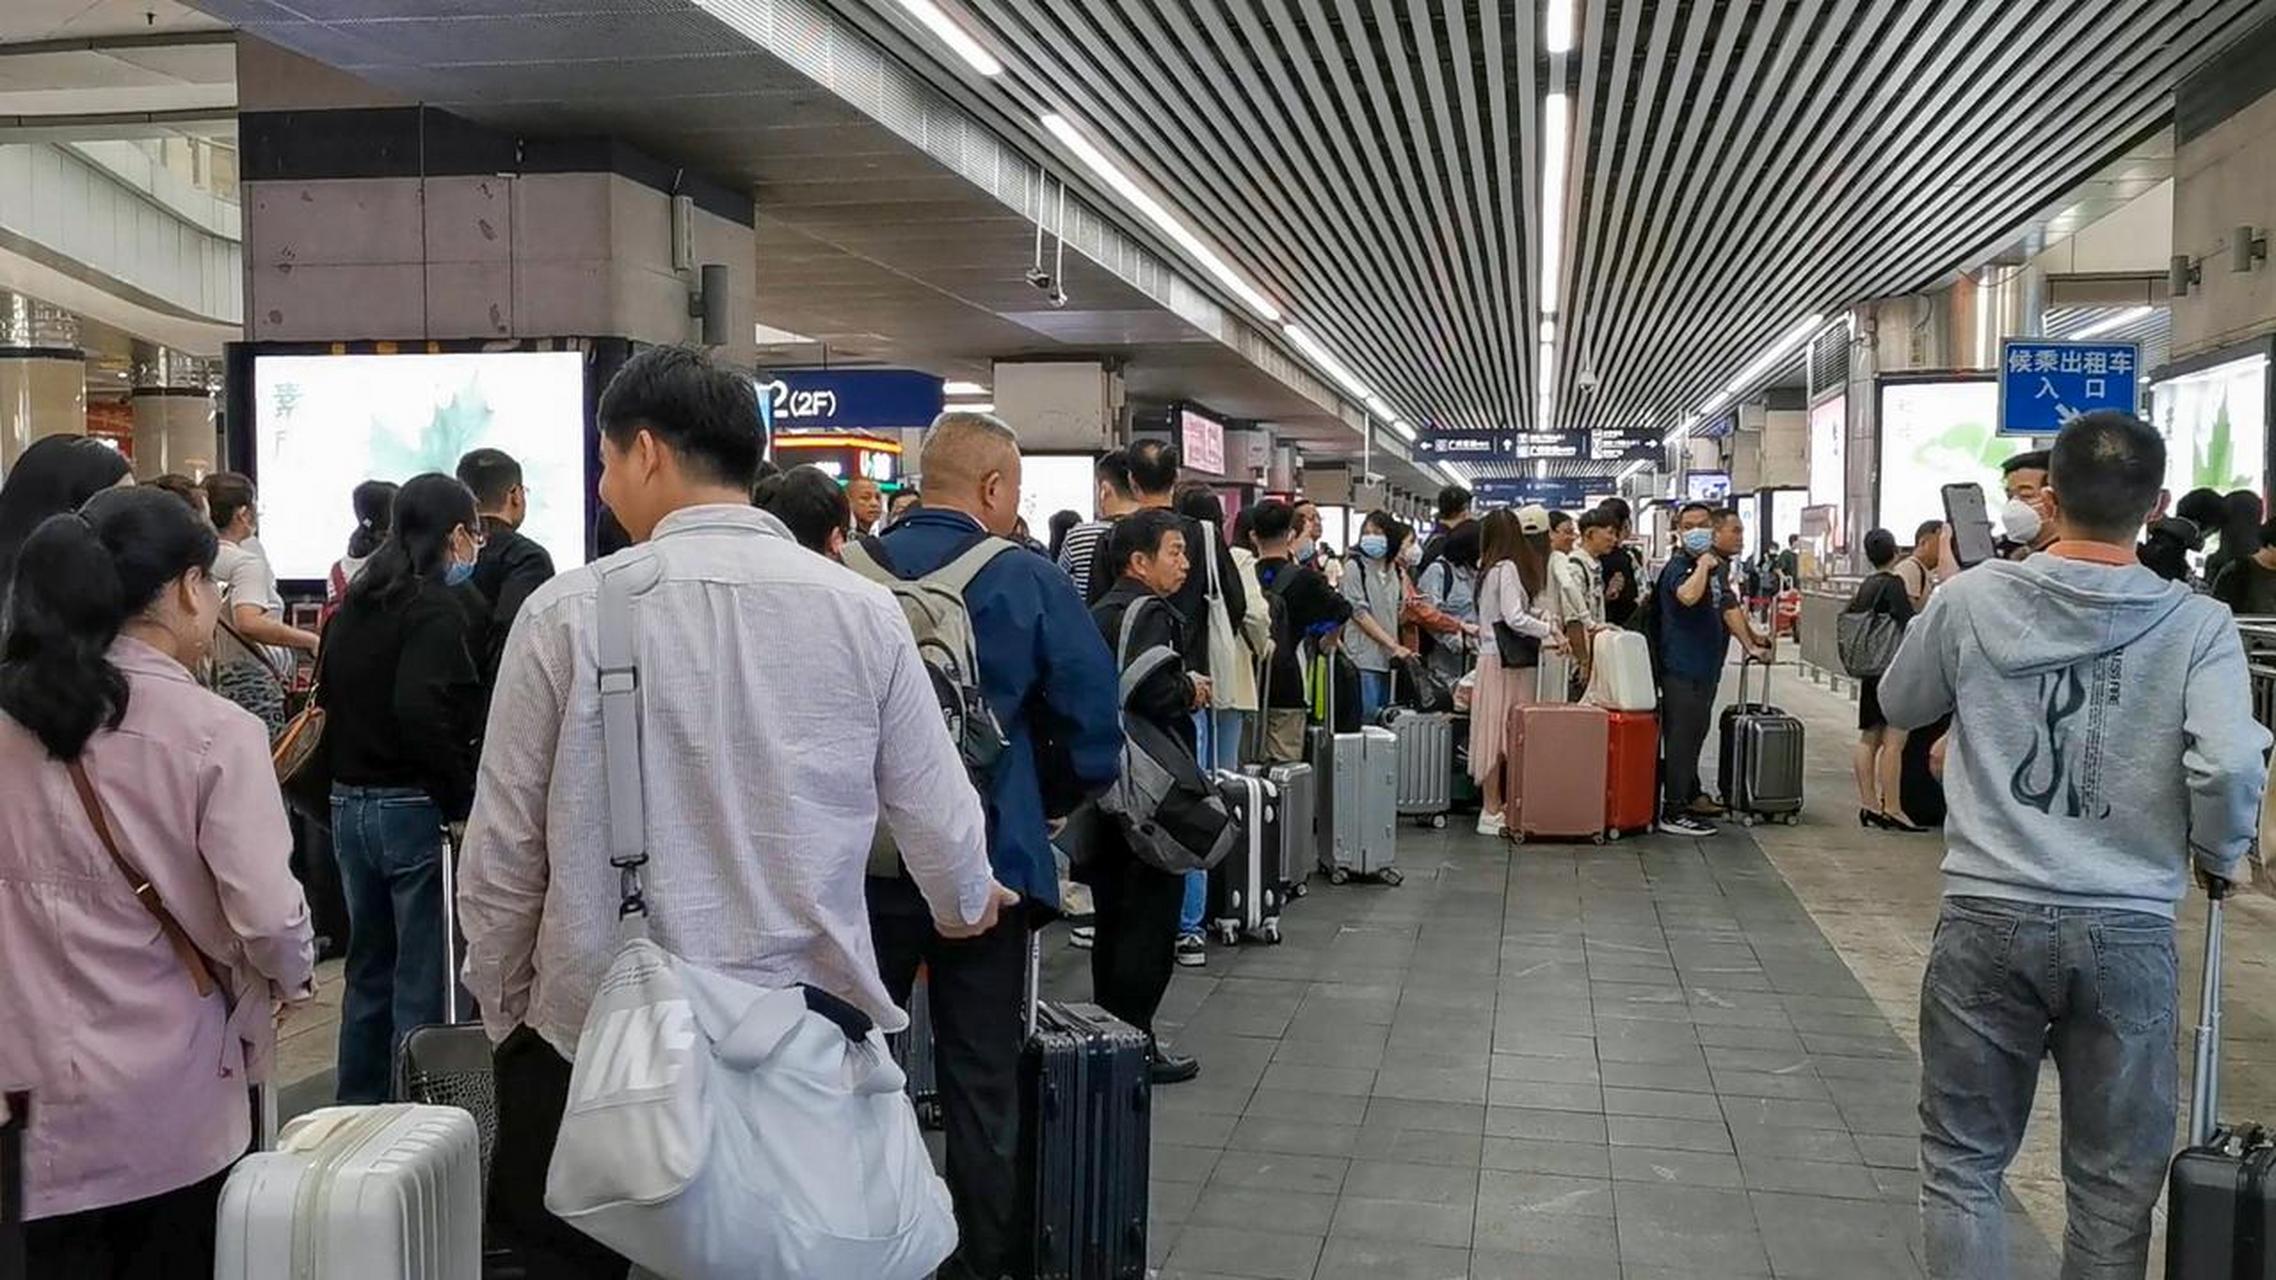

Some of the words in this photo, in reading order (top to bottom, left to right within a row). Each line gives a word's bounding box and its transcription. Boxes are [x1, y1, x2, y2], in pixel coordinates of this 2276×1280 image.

[2008, 350, 2134, 375] 候乘出租车
[2034, 376, 2106, 399] 入口
